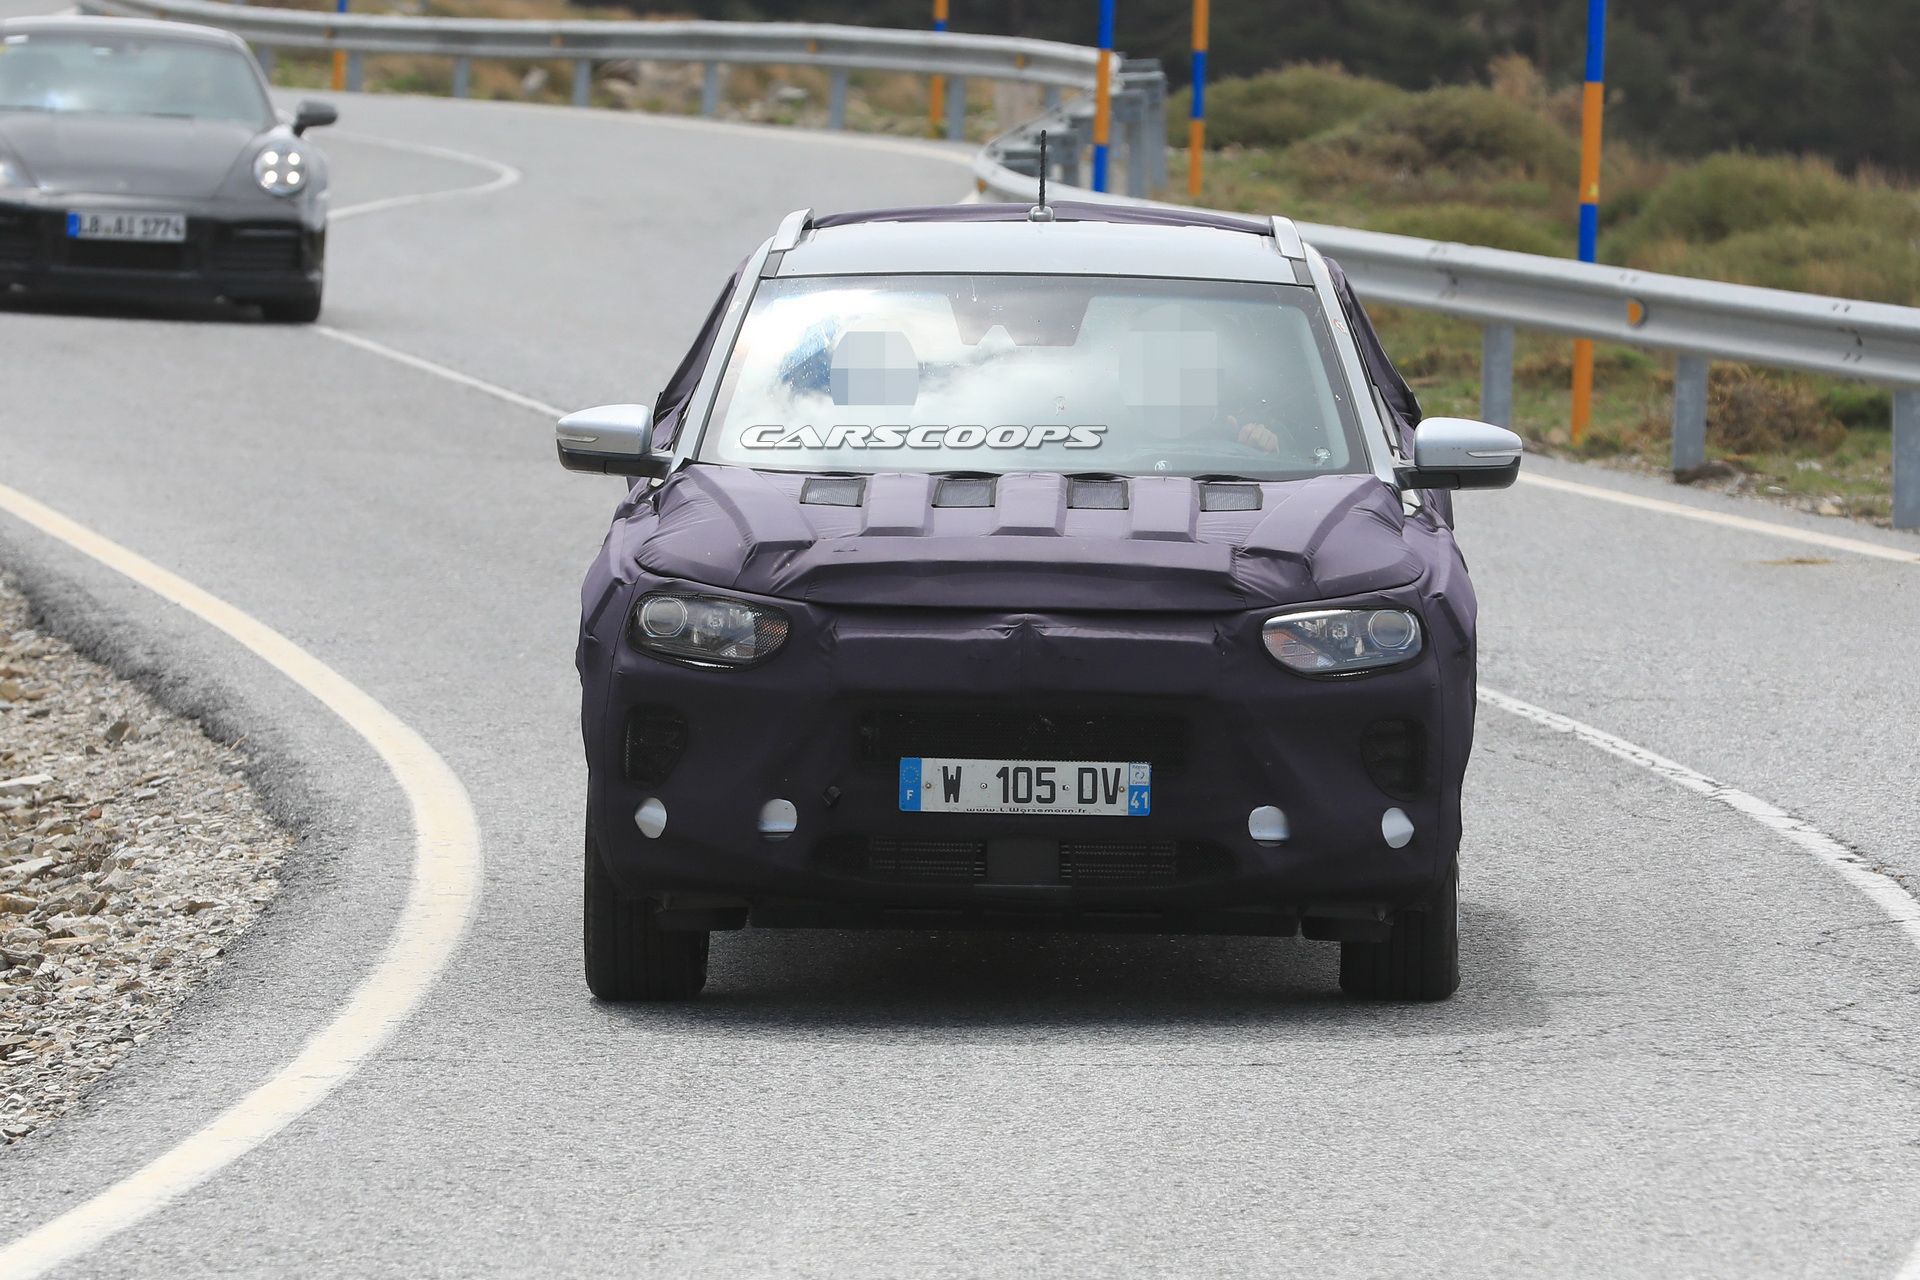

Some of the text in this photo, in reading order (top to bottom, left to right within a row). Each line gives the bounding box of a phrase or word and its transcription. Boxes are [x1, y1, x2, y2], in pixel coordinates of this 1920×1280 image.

[942, 765, 1122, 805] W 105 DV
[906, 789, 914, 801] F
[1130, 791, 1149, 809] 41
